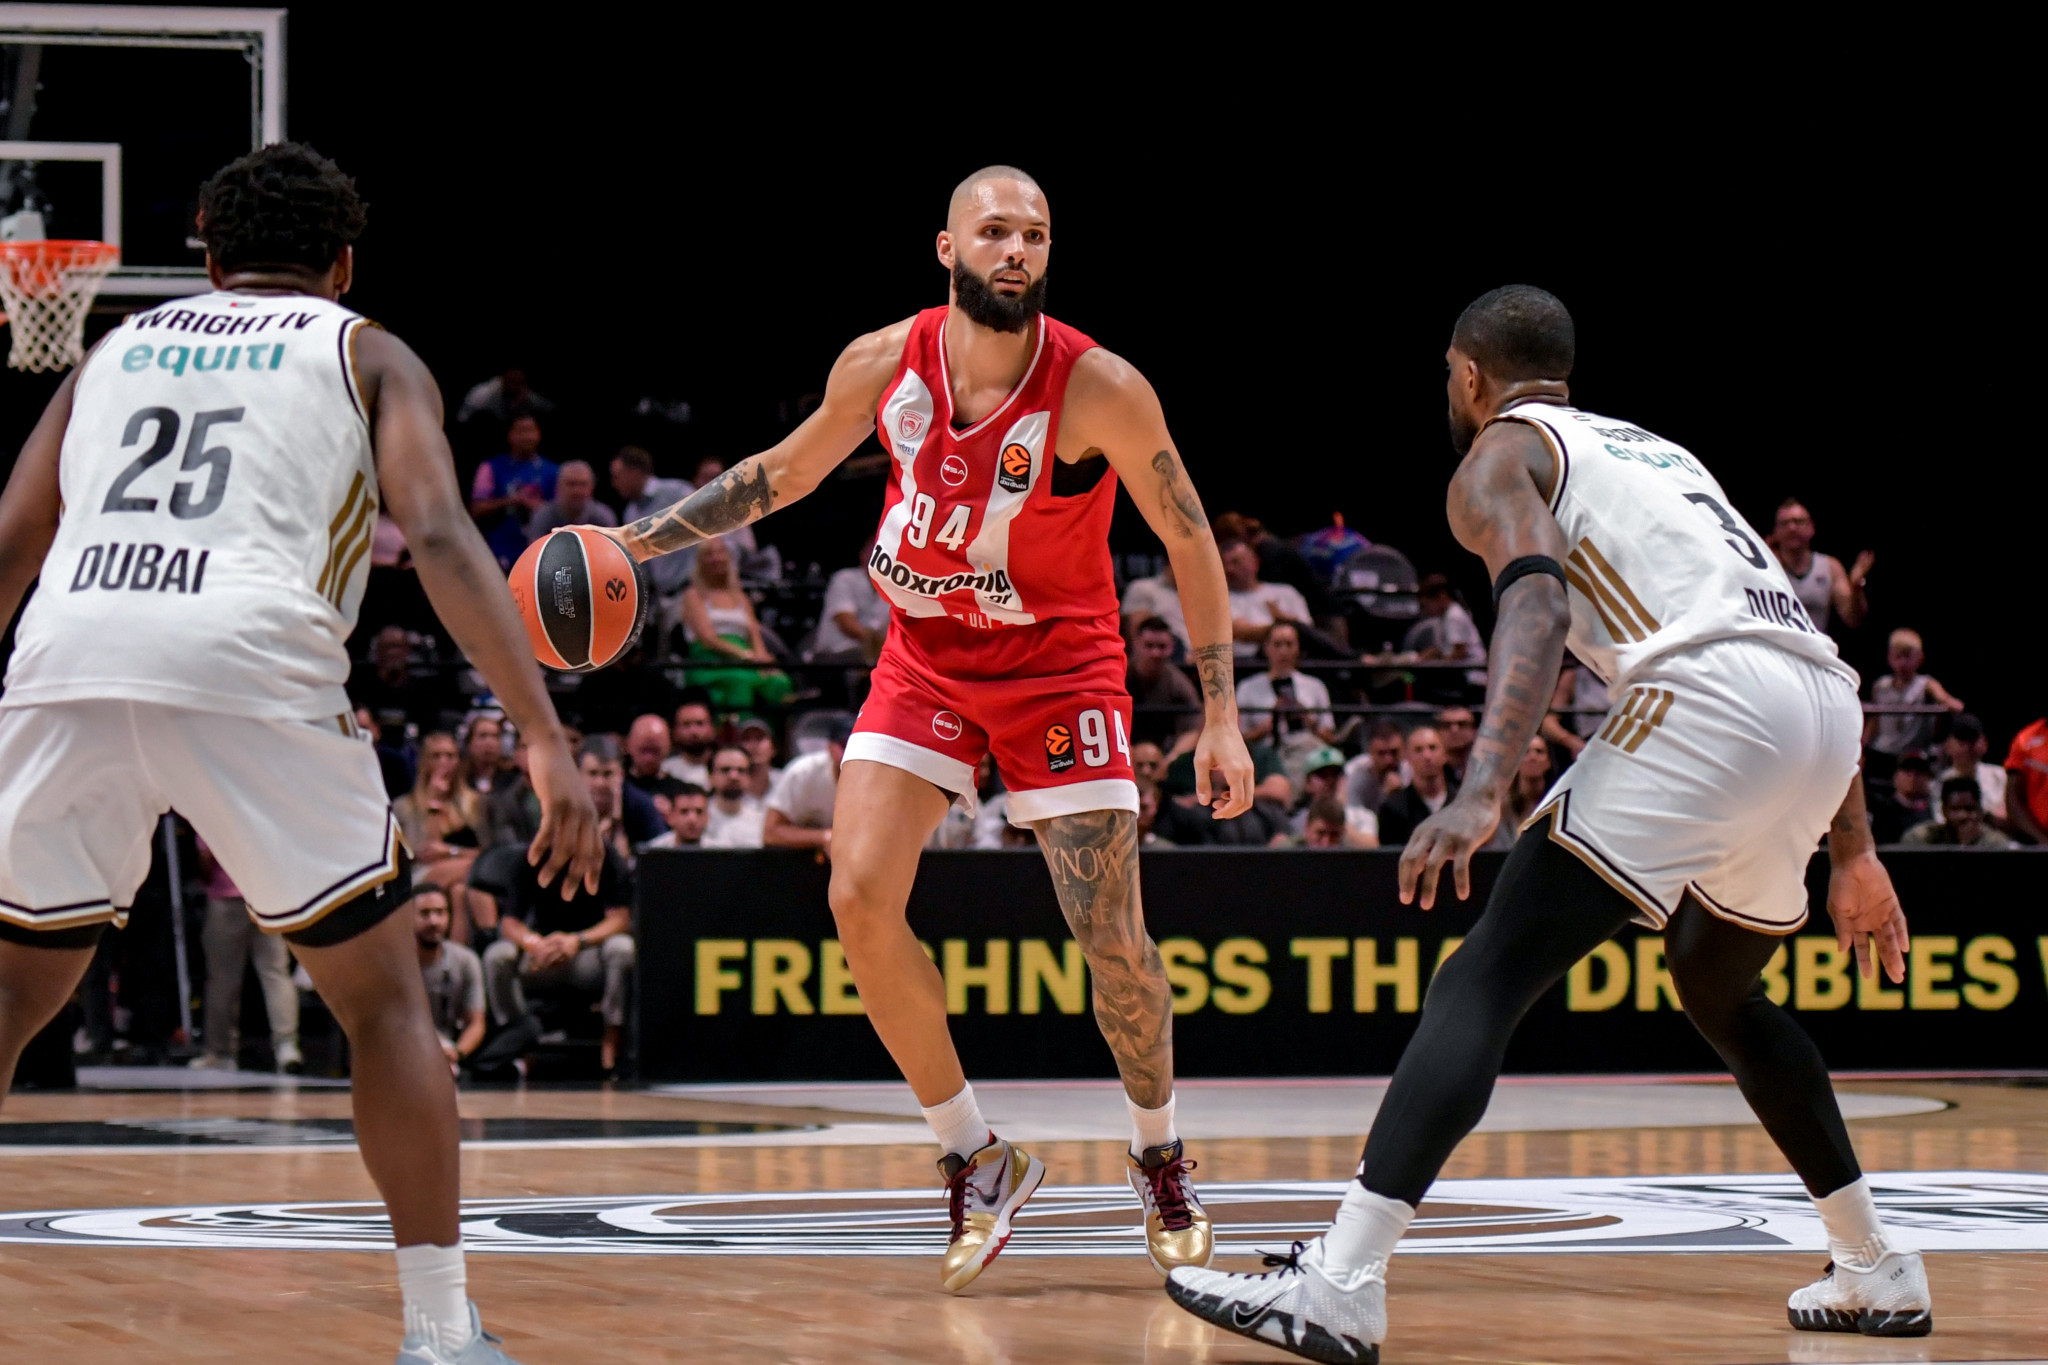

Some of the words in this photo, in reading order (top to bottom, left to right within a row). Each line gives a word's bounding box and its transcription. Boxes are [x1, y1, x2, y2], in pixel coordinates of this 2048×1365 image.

[136, 309, 280, 335] WRIGHT
[279, 312, 321, 330] IV
[101, 406, 246, 520] 25
[907, 492, 972, 551] 94
[1681, 492, 1768, 569] 3
[69, 543, 210, 594] DUBAI
[1078, 708, 1132, 768] 94
